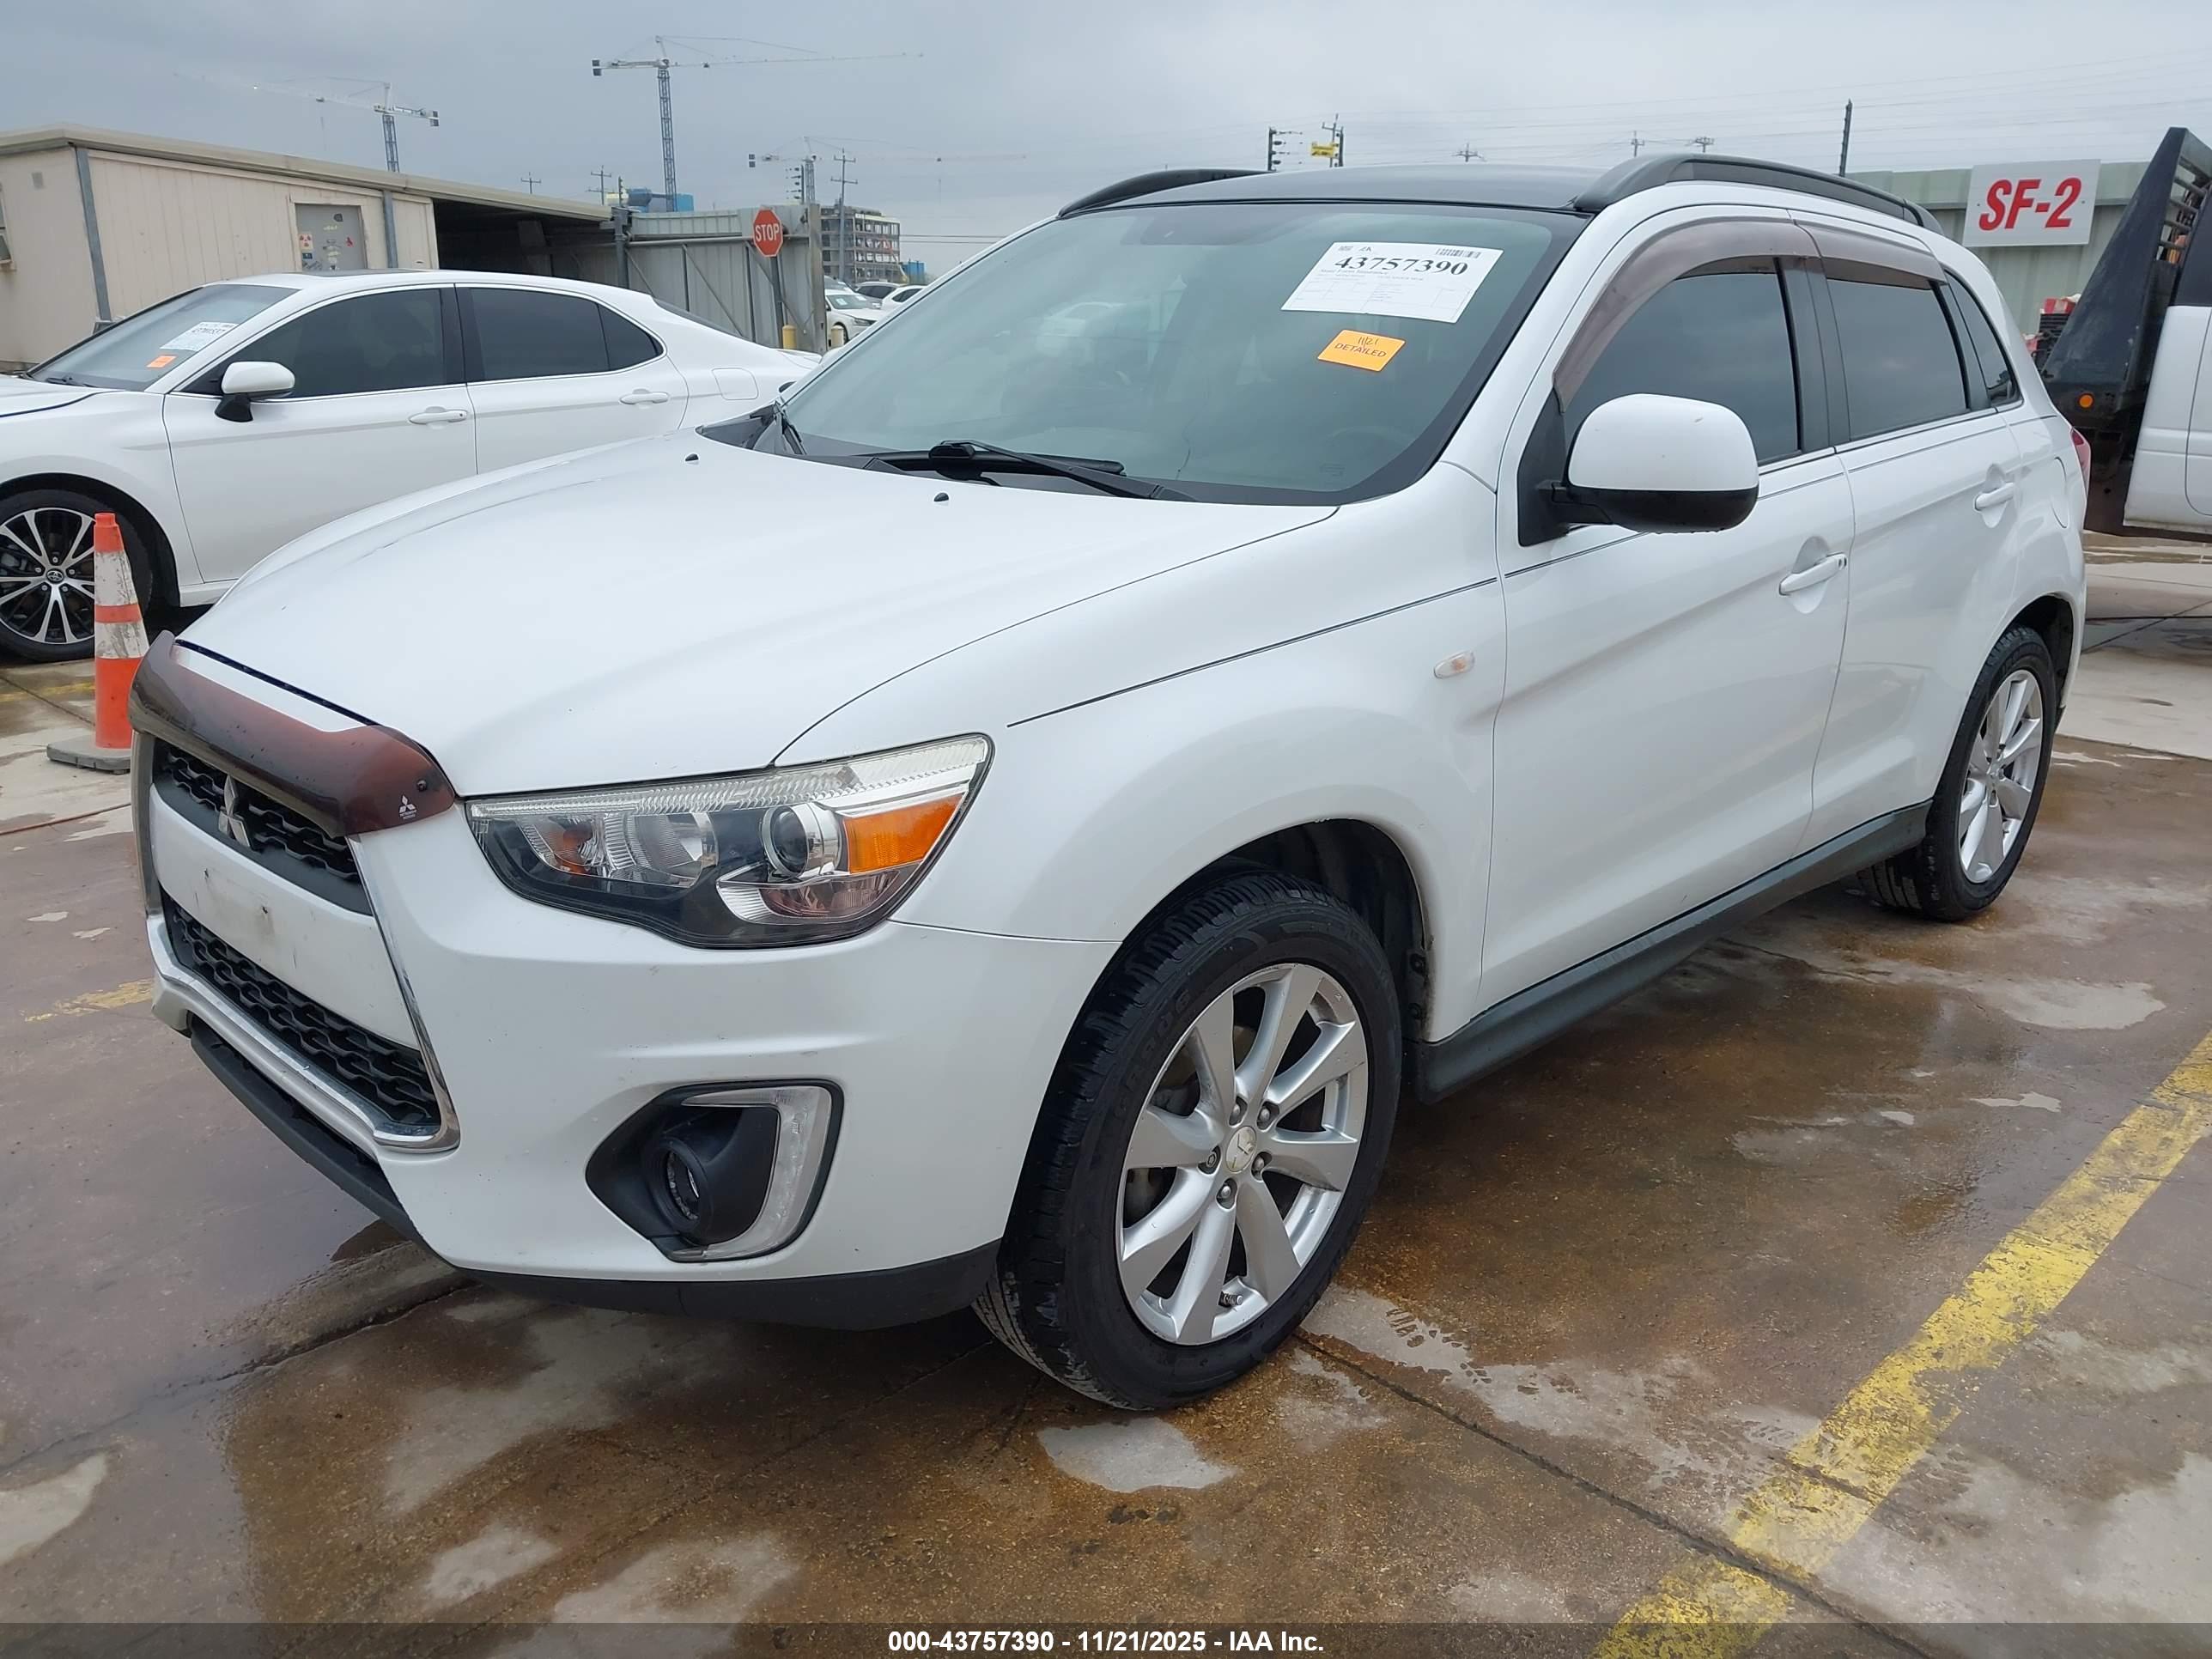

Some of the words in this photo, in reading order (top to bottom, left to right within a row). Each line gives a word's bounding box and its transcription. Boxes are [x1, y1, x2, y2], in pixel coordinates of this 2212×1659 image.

[1978, 177, 2081, 230] SF-2
[756, 223, 779, 241] STOP
[1334, 256, 1468, 276] 43757390
[1334, 343, 1388, 357] DETAILED
